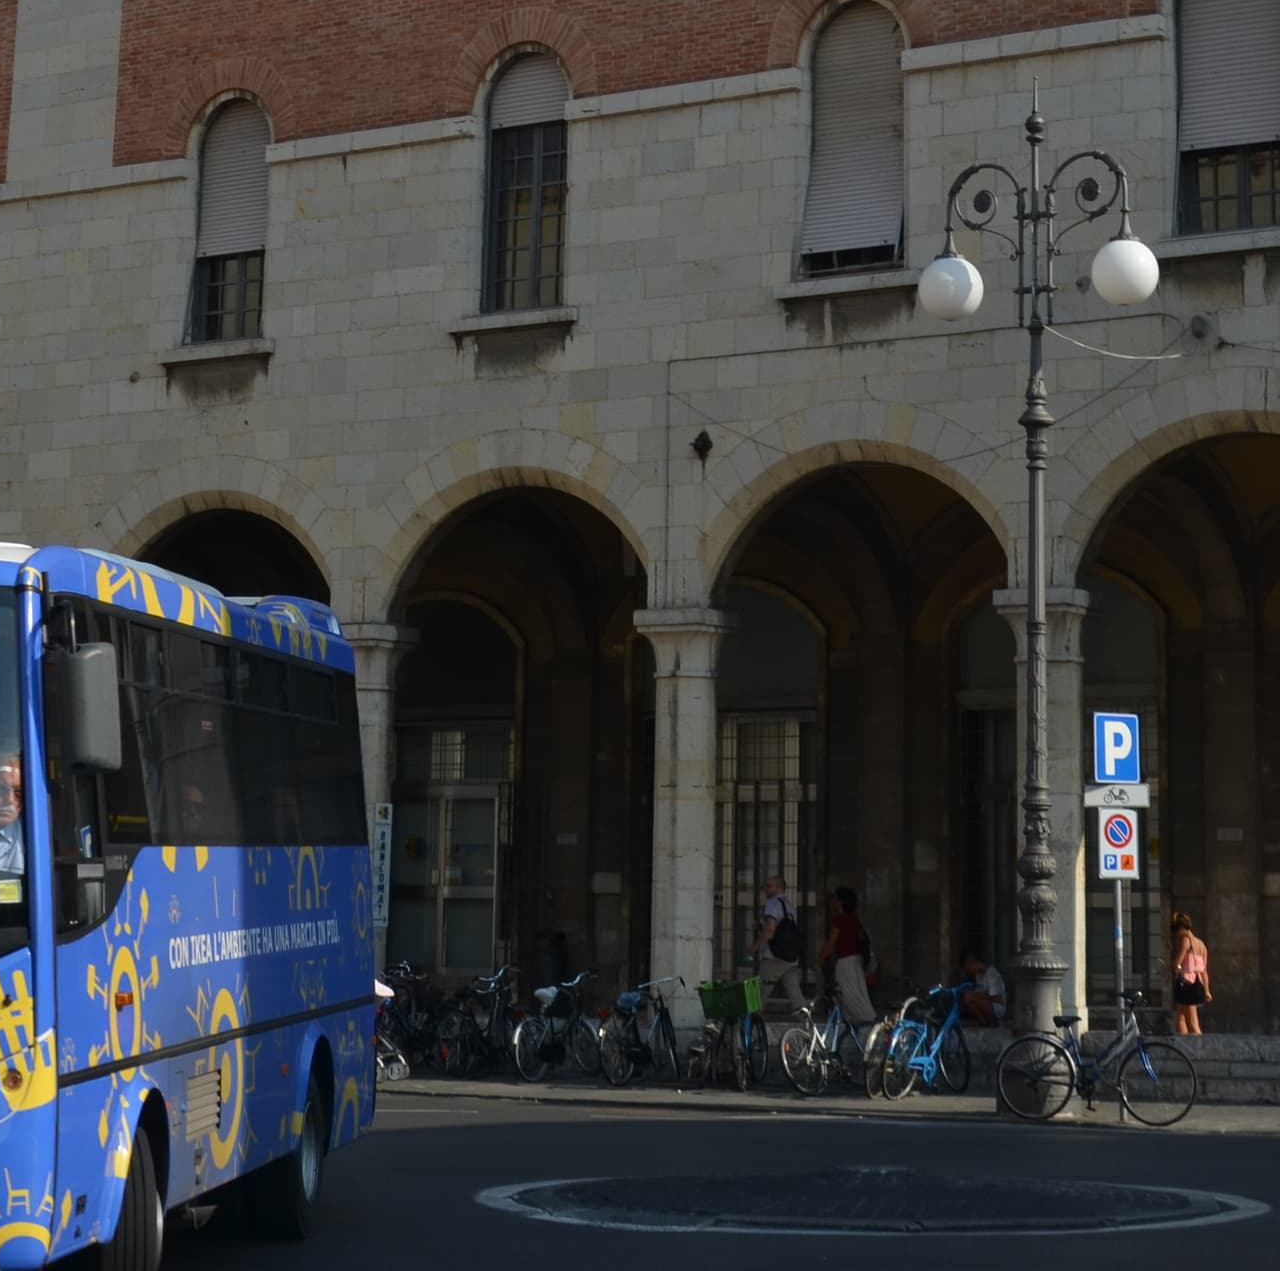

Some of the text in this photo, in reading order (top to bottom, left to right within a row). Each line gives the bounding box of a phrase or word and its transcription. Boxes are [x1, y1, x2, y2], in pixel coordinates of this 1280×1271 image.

[1104, 720, 1132, 776] P
[377, 830, 387, 916] BANCOMAT
[169, 937, 190, 969] CON
[191, 933, 213, 966] IKEA
[214, 927, 261, 963] L'AMBIENTE
[262, 926, 273, 953] HA
[274, 923, 290, 952] UNA
[290, 921, 317, 949] MARCIA
[317, 920, 326, 946] IN
